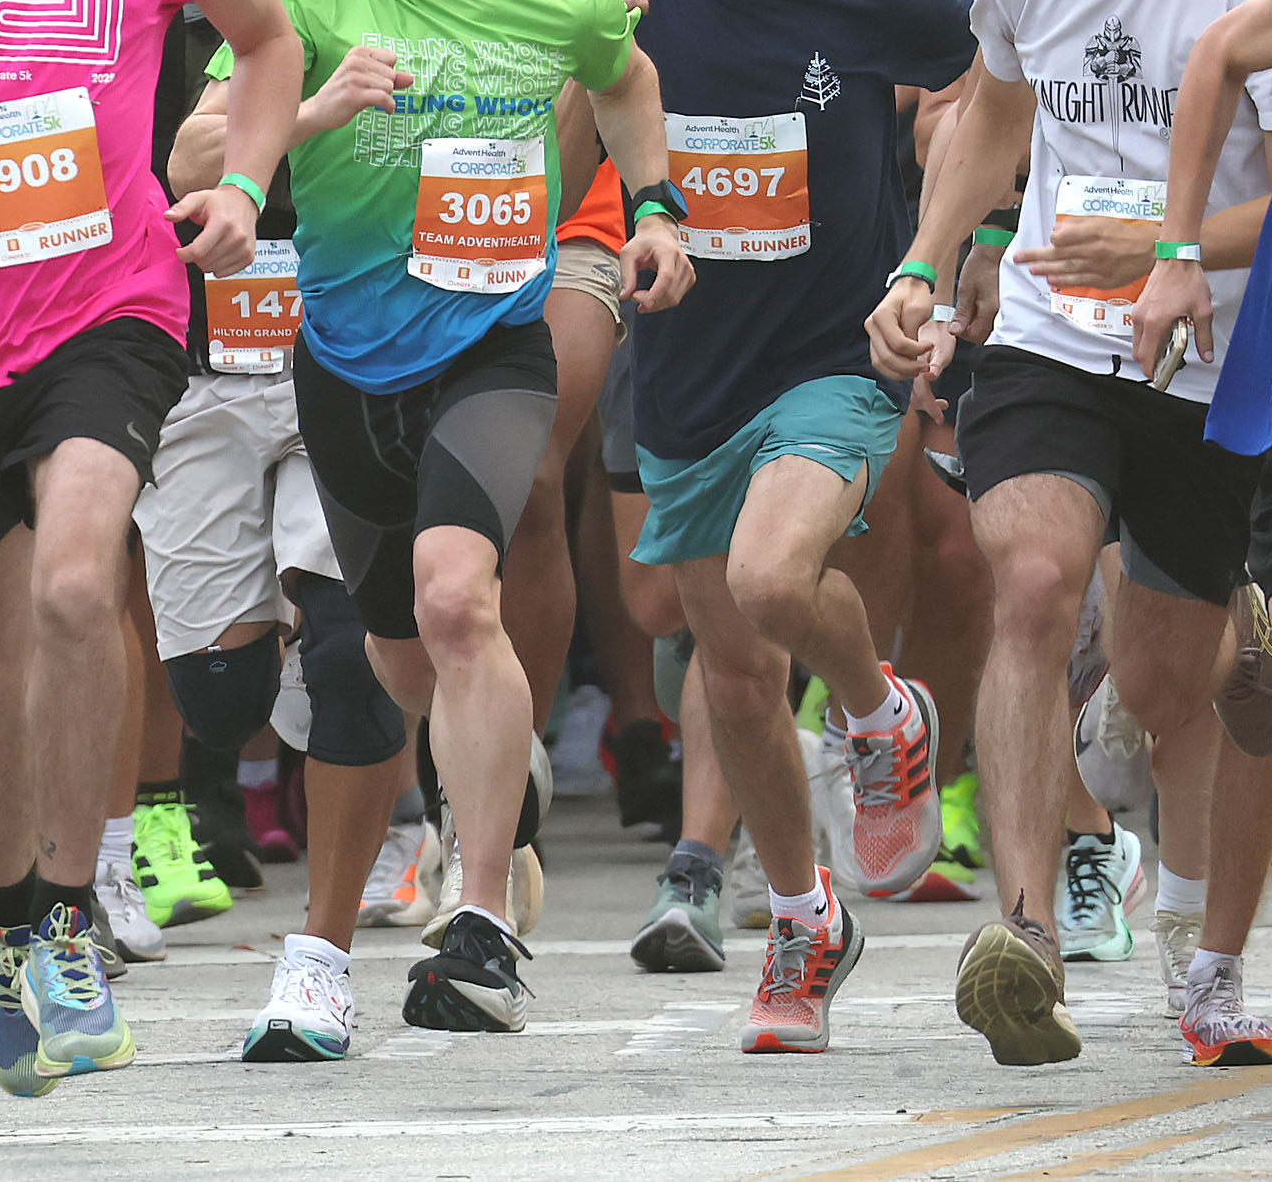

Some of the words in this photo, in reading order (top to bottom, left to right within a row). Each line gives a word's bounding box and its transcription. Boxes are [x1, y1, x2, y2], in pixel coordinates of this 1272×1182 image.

[19, 70, 33, 81] 5k
[1122, 83, 1179, 128] RUNNE
[681, 166, 785, 197] 4697
[438, 192, 532, 226] 3065
[39, 222, 108, 250] RUNNER
[419, 232, 454, 245] TEAM
[457, 235, 541, 248] ADVENTHEALTH
[741, 235, 808, 252] RUNNER
[487, 270, 526, 285] RUNN
[232, 290, 303, 318] 147
[213, 328, 251, 337] HILTON
[254, 328, 292, 337] GRAND
